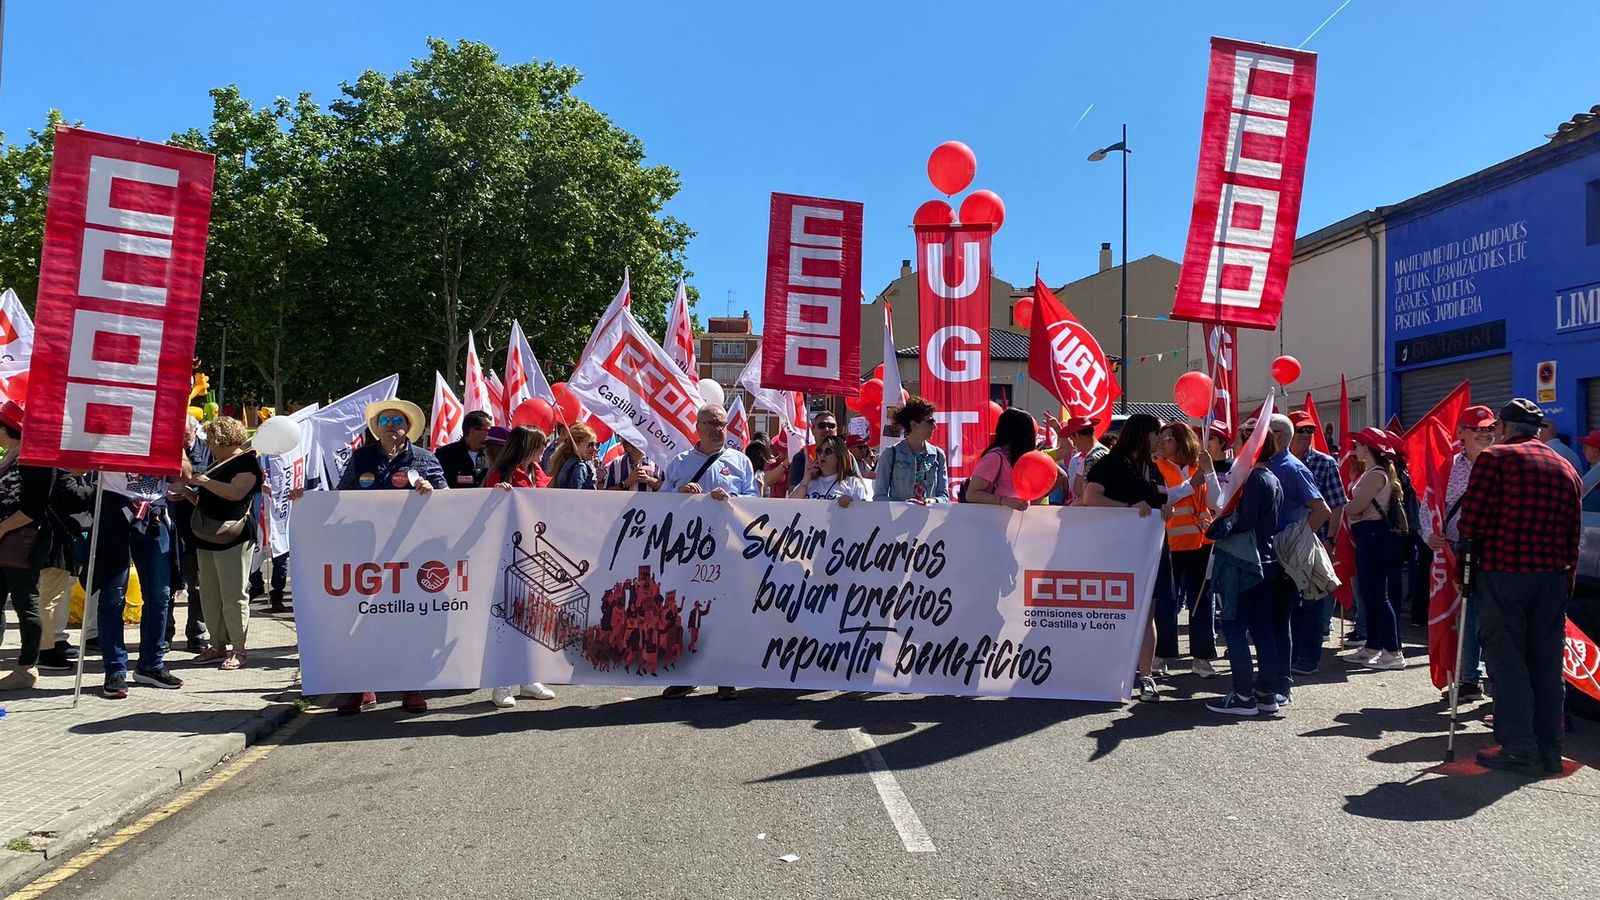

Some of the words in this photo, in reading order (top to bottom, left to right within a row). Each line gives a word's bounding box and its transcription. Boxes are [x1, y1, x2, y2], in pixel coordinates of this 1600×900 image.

[1200, 49, 1295, 309] CCOO
[1394, 242, 1460, 276] MANTENIMIENTO
[1463, 220, 1528, 256] COMUNIDADES
[1509, 241, 1528, 264] ETC
[60, 155, 179, 457] CCOO
[784, 204, 844, 380] CCOO
[1432, 276, 1476, 303] MOQUETAS
[1434, 295, 1483, 322] JARDINERIA
[927, 241, 981, 467] UGT
[1051, 327, 1106, 397] UGT
[598, 385, 637, 419] Castilla
[635, 415, 647, 427] y
[646, 421, 677, 451] León
[614, 343, 700, 434] CCOO
[691, 564, 721, 583] 2023
[743, 512, 828, 562] Subir
[825, 526, 947, 579] salarios
[324, 562, 409, 597] UGT
[358, 600, 415, 614] Castilla
[419, 601, 428, 615] y
[432, 598, 469, 612] León
[752, 564, 839, 624] bajar
[839, 581, 953, 634] precios
[1031, 577, 1128, 603] CCOO
[1024, 609, 1083, 619] comisiones
[1086, 610, 1127, 620] obreras
[1024, 619, 1037, 628] de
[1040, 619, 1078, 629] Castilla
[1081, 621, 1087, 630] y
[1090, 620, 1116, 631] León
[761, 621, 897, 682] repartir
[893, 627, 1052, 686] beneficios
